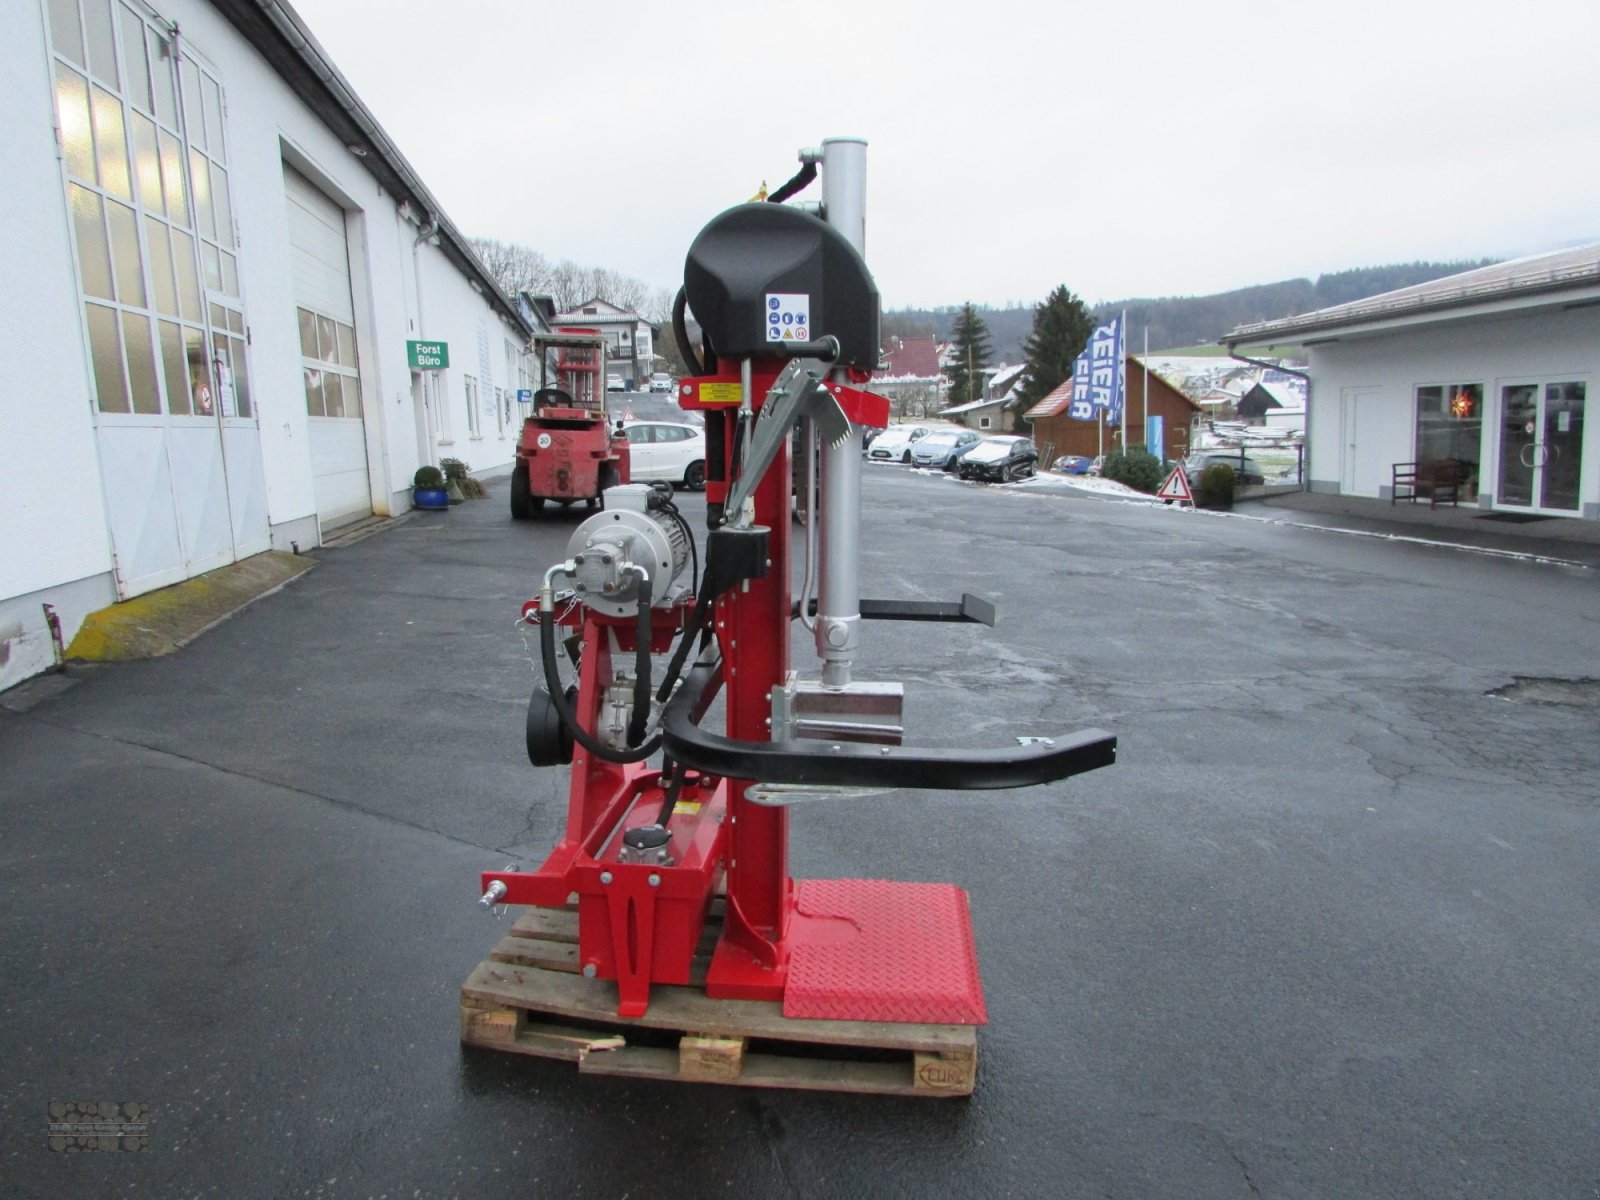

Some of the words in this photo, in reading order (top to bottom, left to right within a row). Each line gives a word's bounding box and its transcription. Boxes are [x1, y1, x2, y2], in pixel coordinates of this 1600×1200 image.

[416, 343, 441, 354] Forst
[418, 355, 441, 366] Büro
[540, 437, 549, 445] 20
